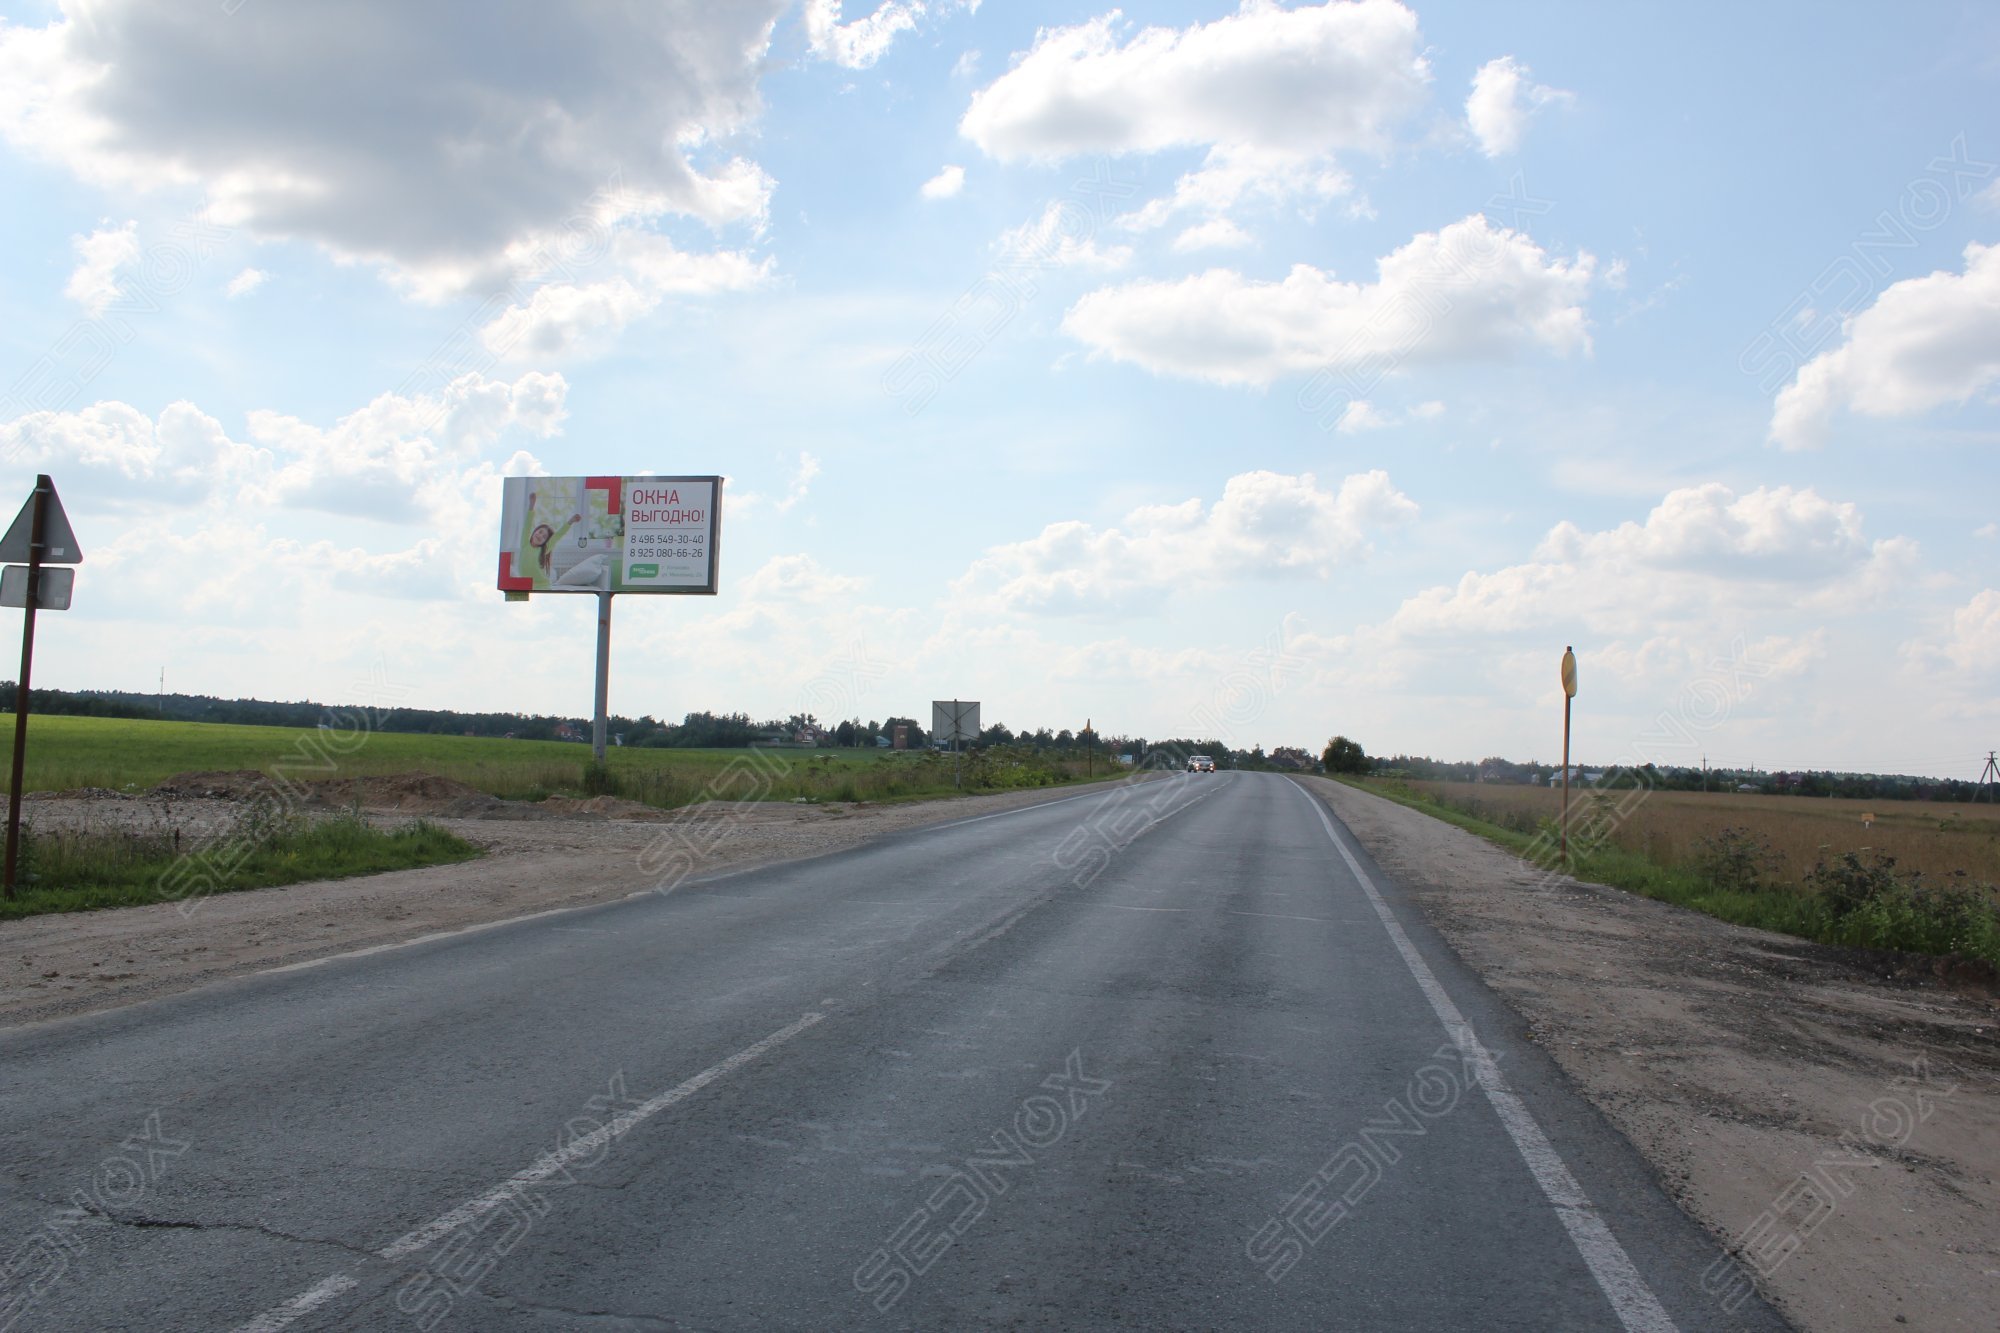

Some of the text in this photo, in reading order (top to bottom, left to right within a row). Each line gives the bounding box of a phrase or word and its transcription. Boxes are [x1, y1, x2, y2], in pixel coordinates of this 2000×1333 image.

[632, 489, 680, 505] ОКНА
[631, 509, 705, 525] ВЫГОДНО!
[630, 534, 704, 544] 8 496 549-30-40
[629, 548, 703, 558] 8 925 080-66-26
